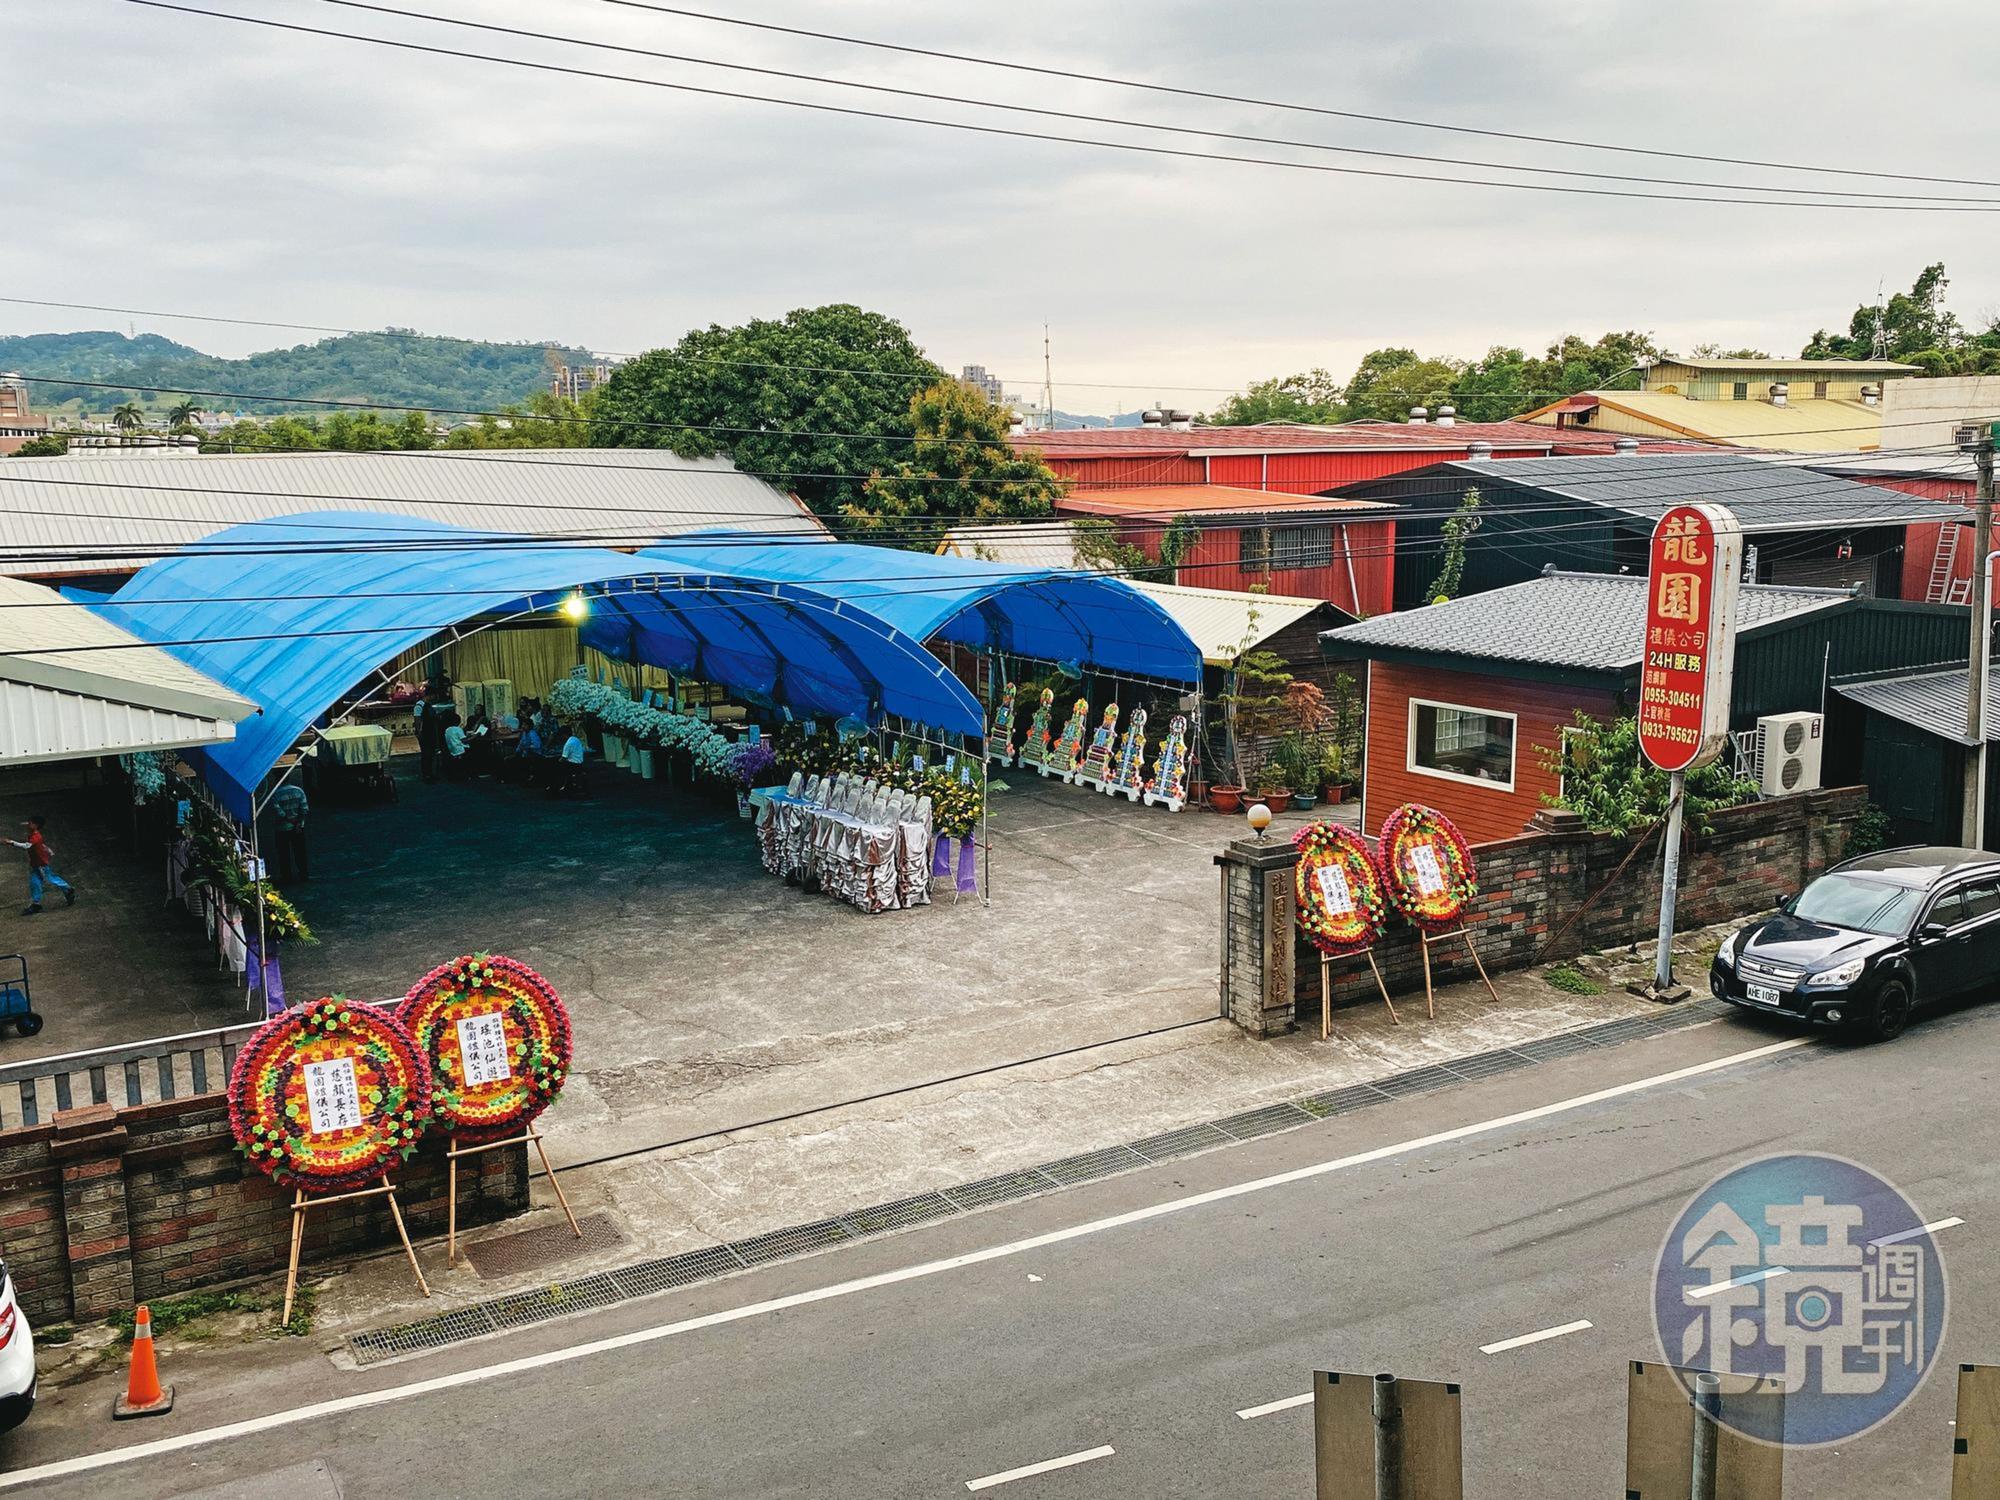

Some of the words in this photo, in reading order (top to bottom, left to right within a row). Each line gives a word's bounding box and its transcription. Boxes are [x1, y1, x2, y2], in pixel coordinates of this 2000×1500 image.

[1657, 515, 1707, 625] 龍園
[1650, 626, 1705, 650] 禮儀公司
[1645, 686, 1701, 710] 0955-304511
[1642, 721, 1699, 745] 0933-795627
